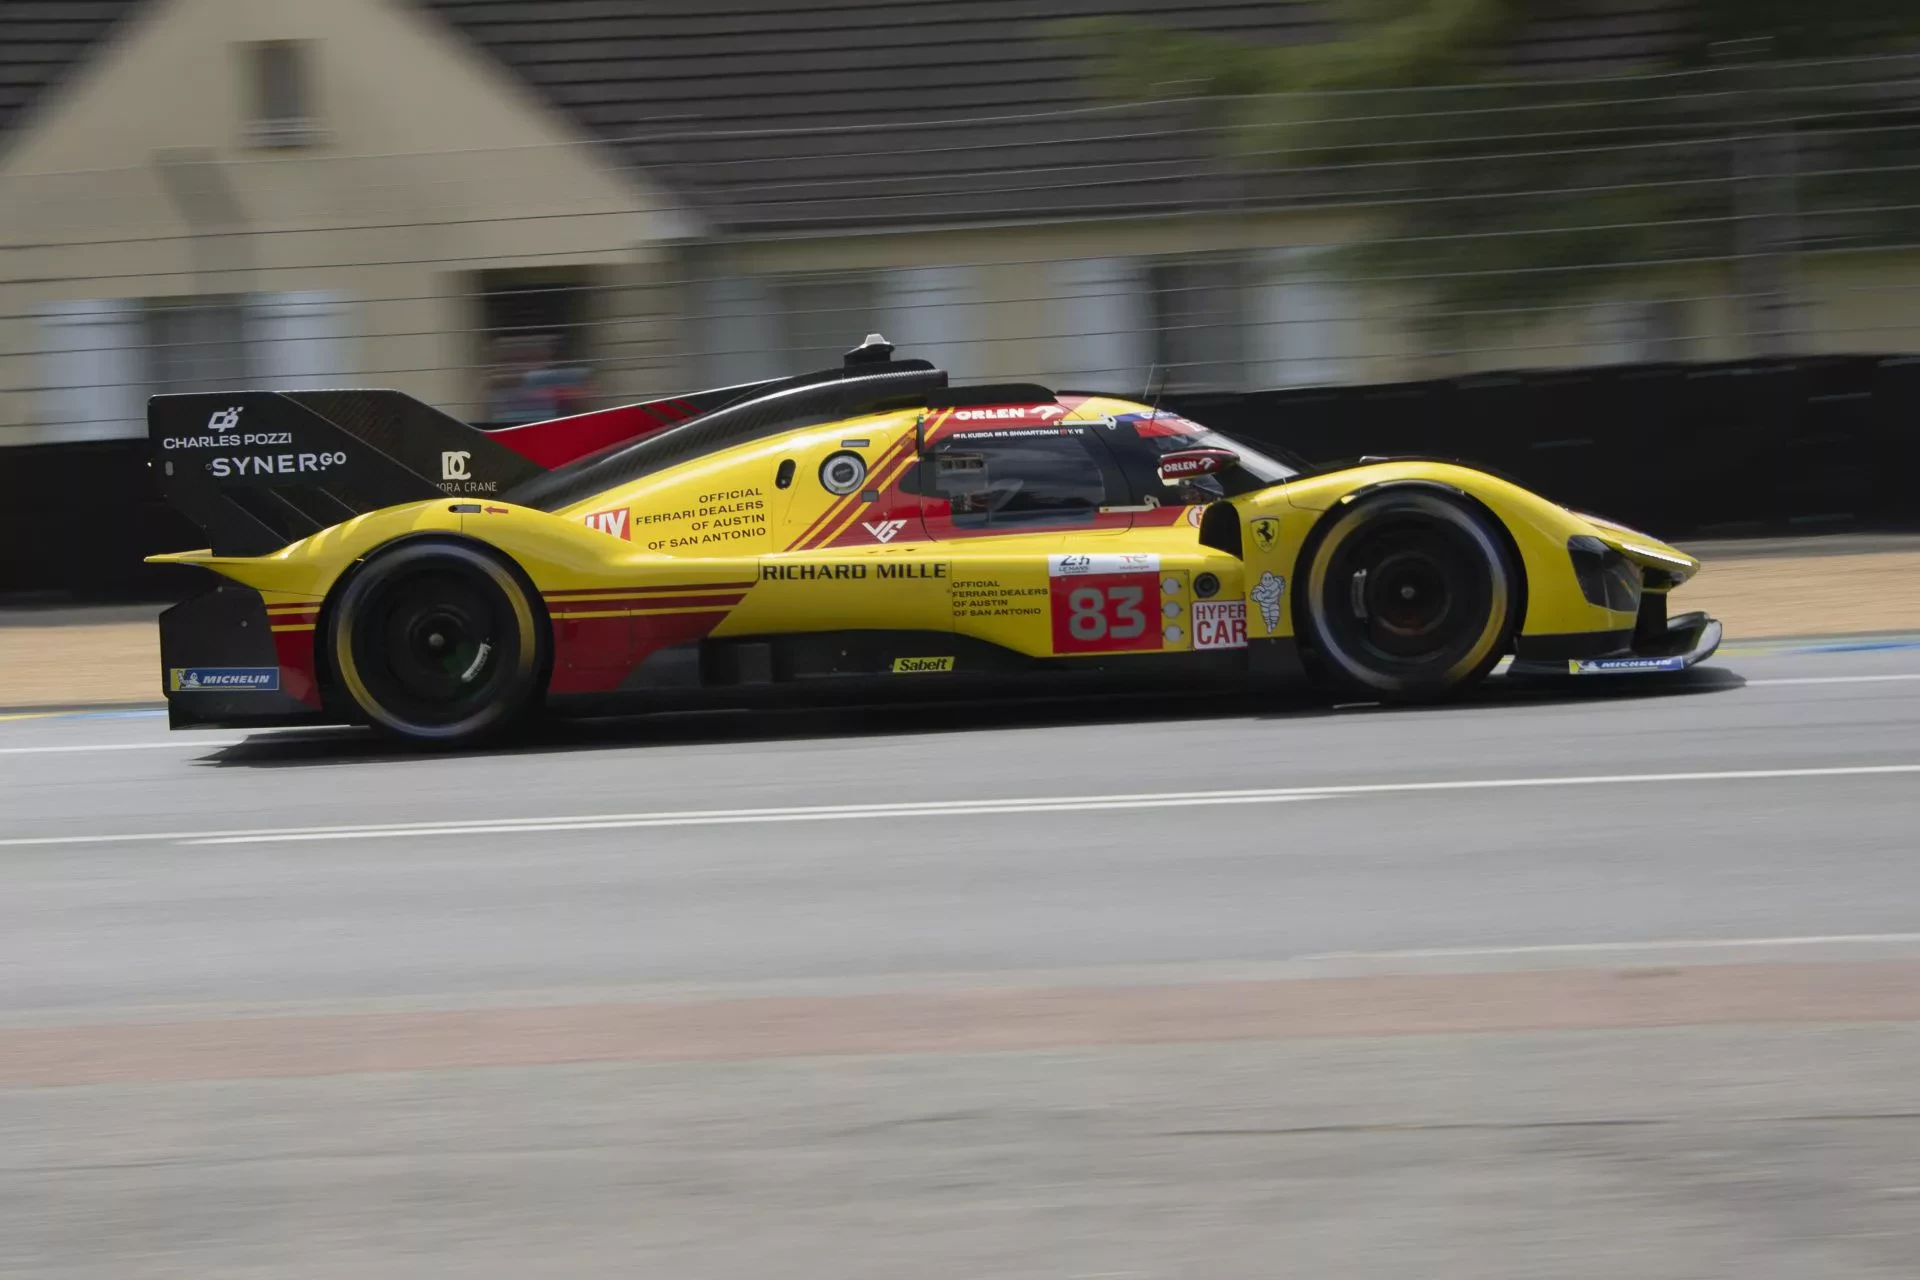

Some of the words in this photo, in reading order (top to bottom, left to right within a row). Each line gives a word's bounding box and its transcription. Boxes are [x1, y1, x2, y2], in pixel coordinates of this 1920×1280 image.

[955, 408, 1025, 420] ORLEN
[163, 434, 241, 449] CHARLES
[244, 432, 292, 446] POZZI
[1163, 461, 1198, 473] ORLEN
[464, 481, 497, 492] CRANE
[698, 488, 763, 504] OFFICIAL
[636, 510, 695, 526] FERRARI
[699, 500, 764, 517] DEALERS
[691, 522, 709, 531] OF
[713, 514, 765, 529] AUSTIN
[648, 540, 666, 550] OF
[670, 536, 699, 548] SAN
[702, 527, 766, 544] ANTONIO
[762, 564, 867, 580] RICHARD
[877, 563, 947, 579] MILLE
[952, 590, 998, 598] FERRARI
[1000, 588, 1049, 596] DEALERS
[970, 599, 1008, 607] AUSTIN
[970, 609, 991, 617] SAN
[1068, 586, 1146, 640] 83
[1196, 604, 1247, 620] HYPER
[1196, 620, 1248, 645] CAR
[899, 659, 948, 671] Sabelt
[1601, 660, 1673, 668] MICHELIN
[203, 675, 270, 684] MICHELIN
